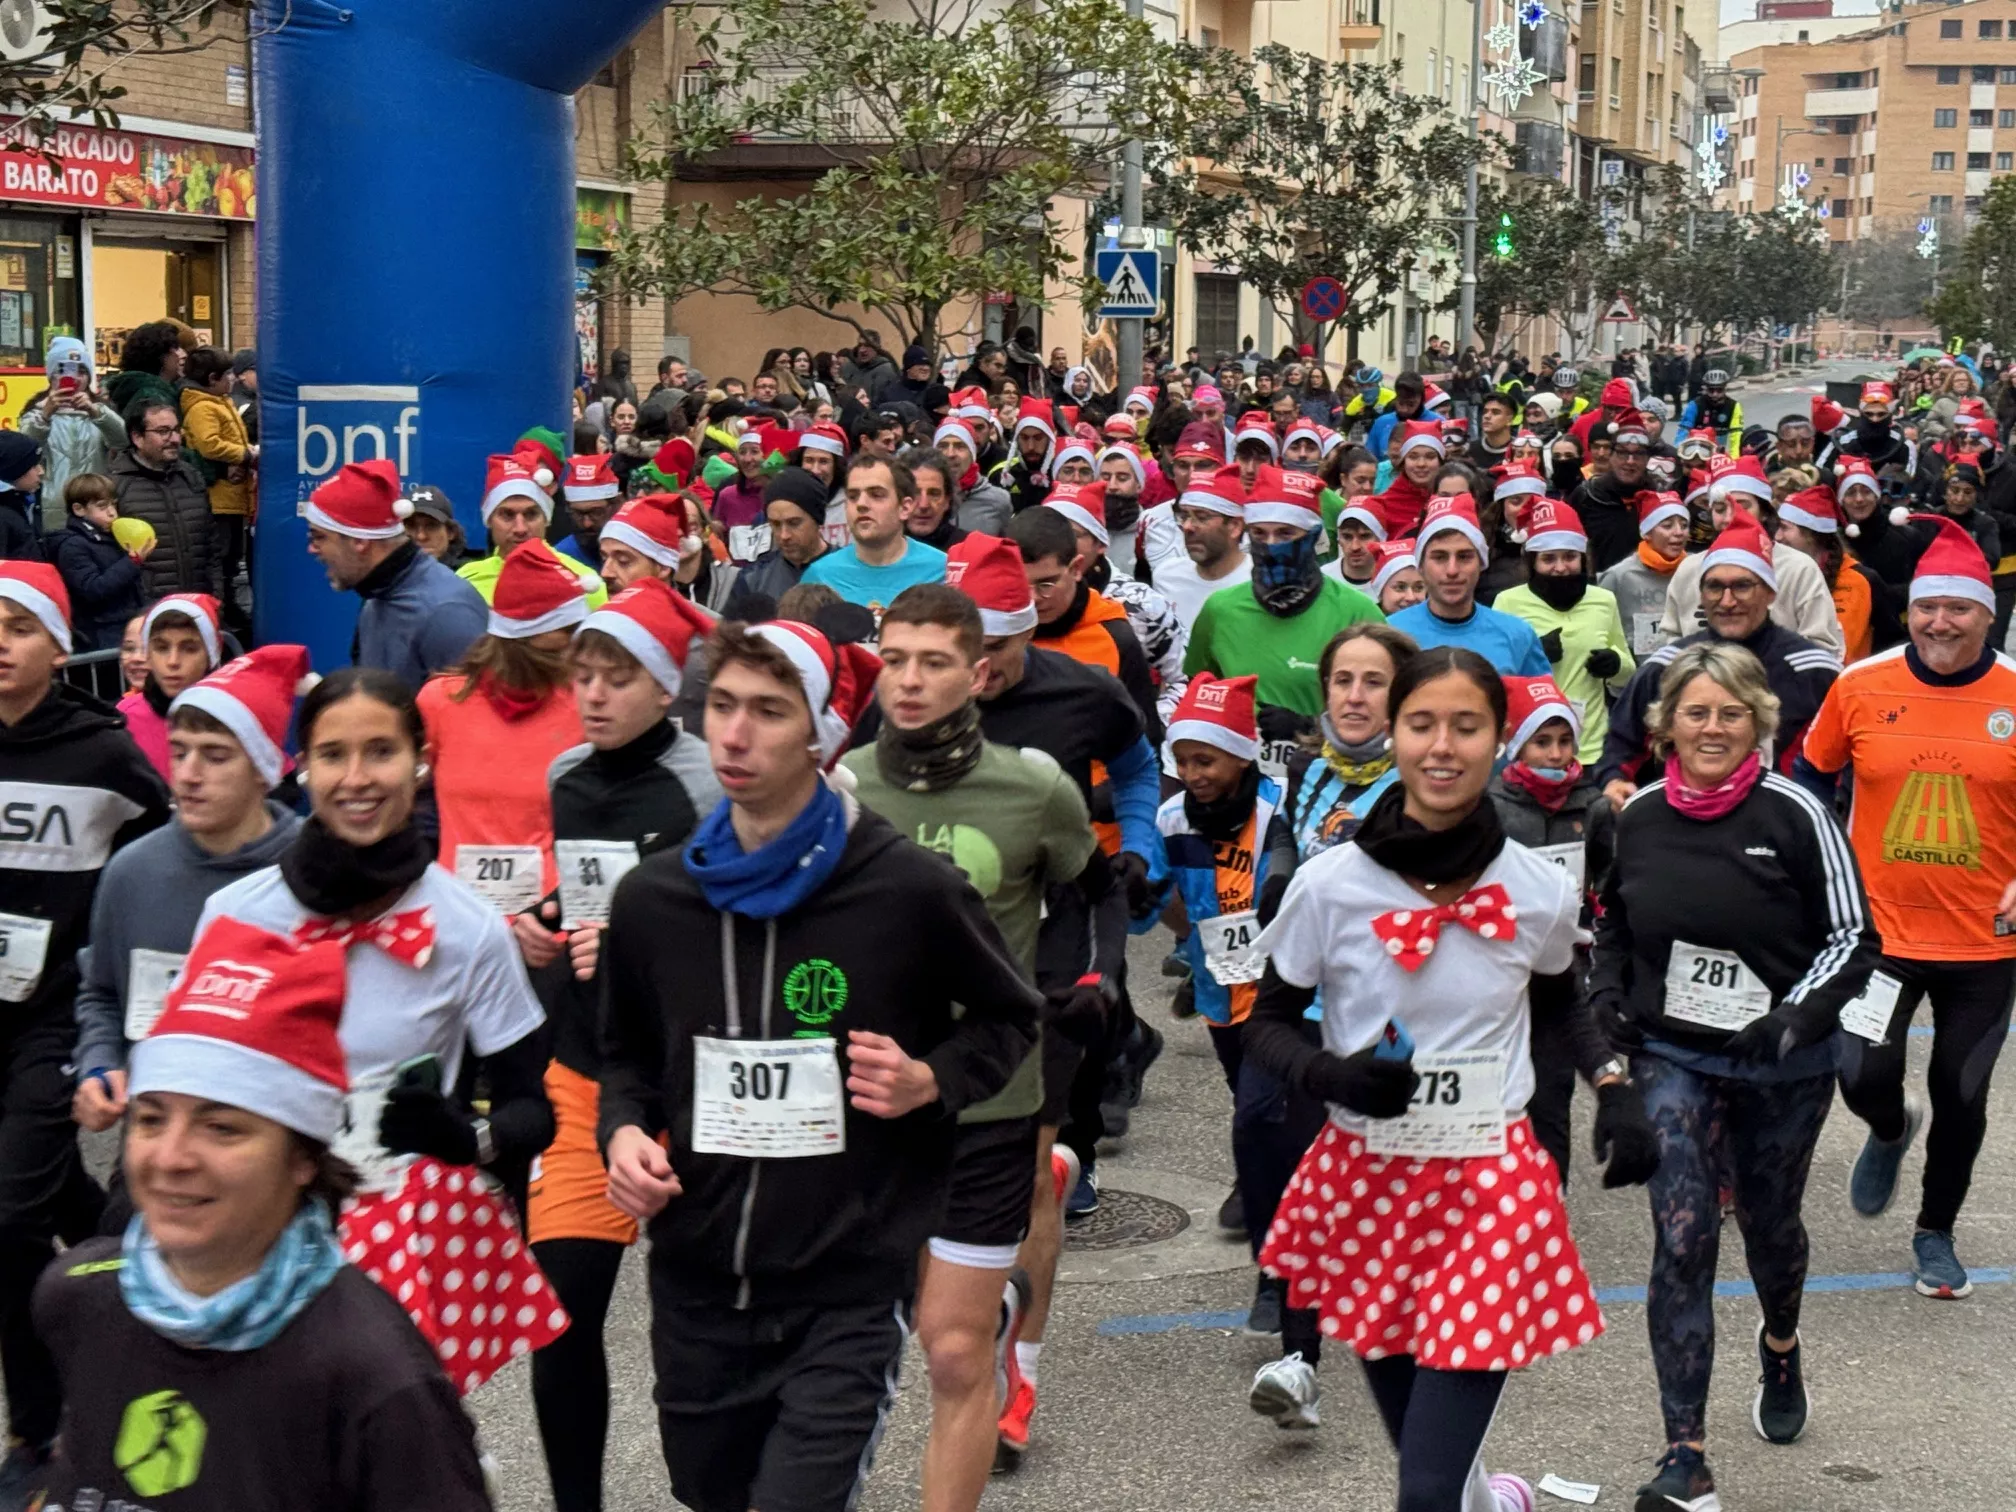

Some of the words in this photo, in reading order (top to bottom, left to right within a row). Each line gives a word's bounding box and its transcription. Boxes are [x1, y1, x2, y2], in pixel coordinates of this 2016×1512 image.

[4, 160, 98, 197] BARATO
[297, 406, 420, 476] bnf
[1197, 685, 1229, 704] bnf
[1260, 741, 1295, 766] 316
[1911, 751, 1962, 770] PALLETS
[477, 857, 516, 881] 207
[1893, 847, 1969, 866] CASTILLO
[187, 969, 273, 1003] bnf
[1691, 957, 1740, 990] 281
[729, 1061, 792, 1101] 307
